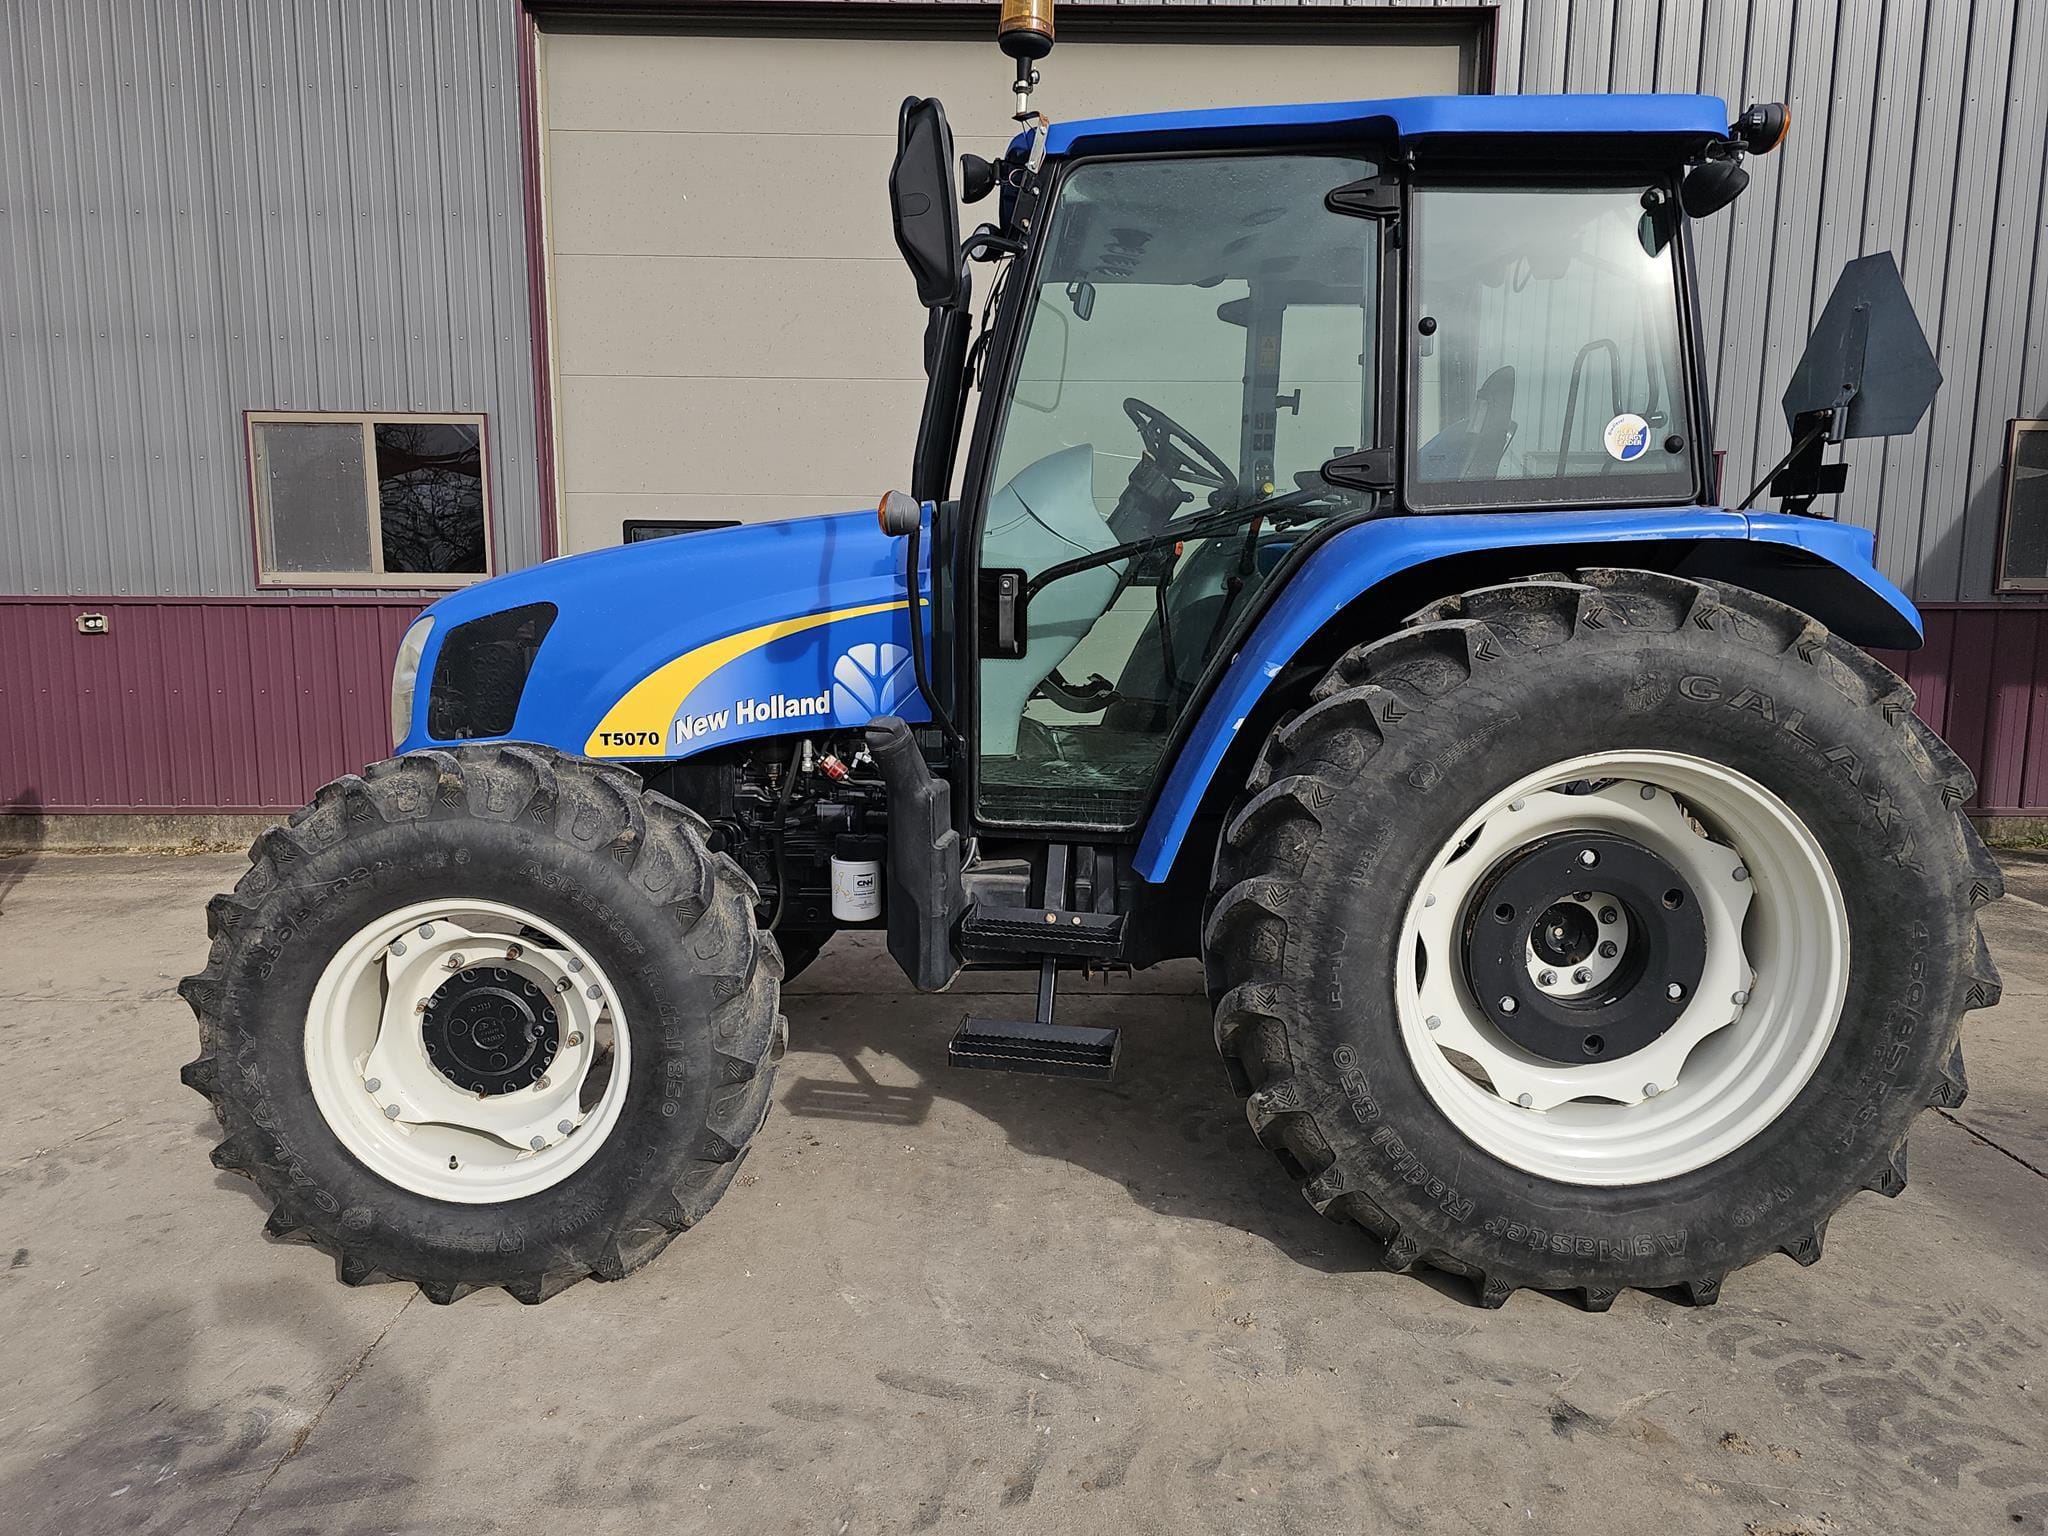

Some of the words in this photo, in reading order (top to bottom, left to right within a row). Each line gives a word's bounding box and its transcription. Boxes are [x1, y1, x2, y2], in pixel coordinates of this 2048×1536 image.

[600, 732, 660, 747] T5070
[674, 709, 729, 745] New
[735, 690, 830, 725] Holland
[1678, 674, 1927, 875] GALAXY
[856, 876, 873, 887] CNH
[519, 859, 646, 954] AgMaster
[661, 1058, 685, 1117] 850
[236, 1026, 340, 1214] GALAXY
[1332, 1044, 1380, 1124] 850
[1369, 1126, 1475, 1222] Radial
[1483, 1217, 1688, 1262] AgMaster
